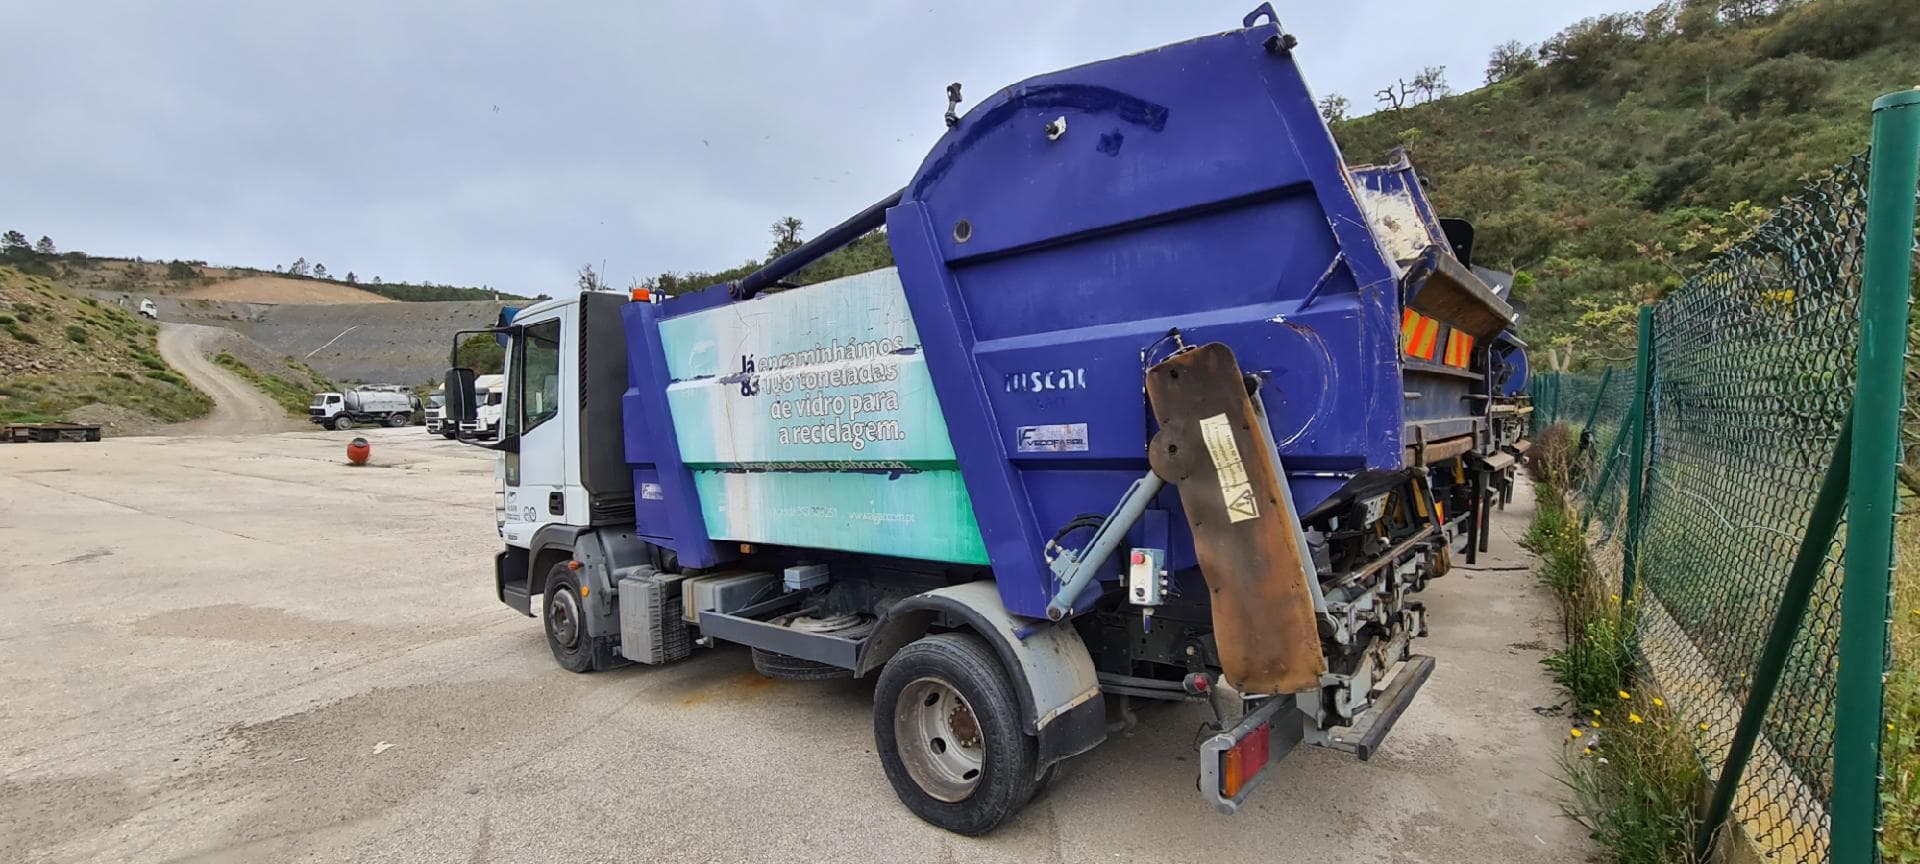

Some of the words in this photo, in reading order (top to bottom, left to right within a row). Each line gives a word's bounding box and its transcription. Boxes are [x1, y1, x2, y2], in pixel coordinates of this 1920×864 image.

[758, 335, 905, 372] encaminhámos
[770, 396, 792, 420] de
[795, 392, 846, 418] vidro
[849, 390, 900, 421] para
[778, 426, 790, 445] a
[793, 416, 906, 451] reciclagem.
